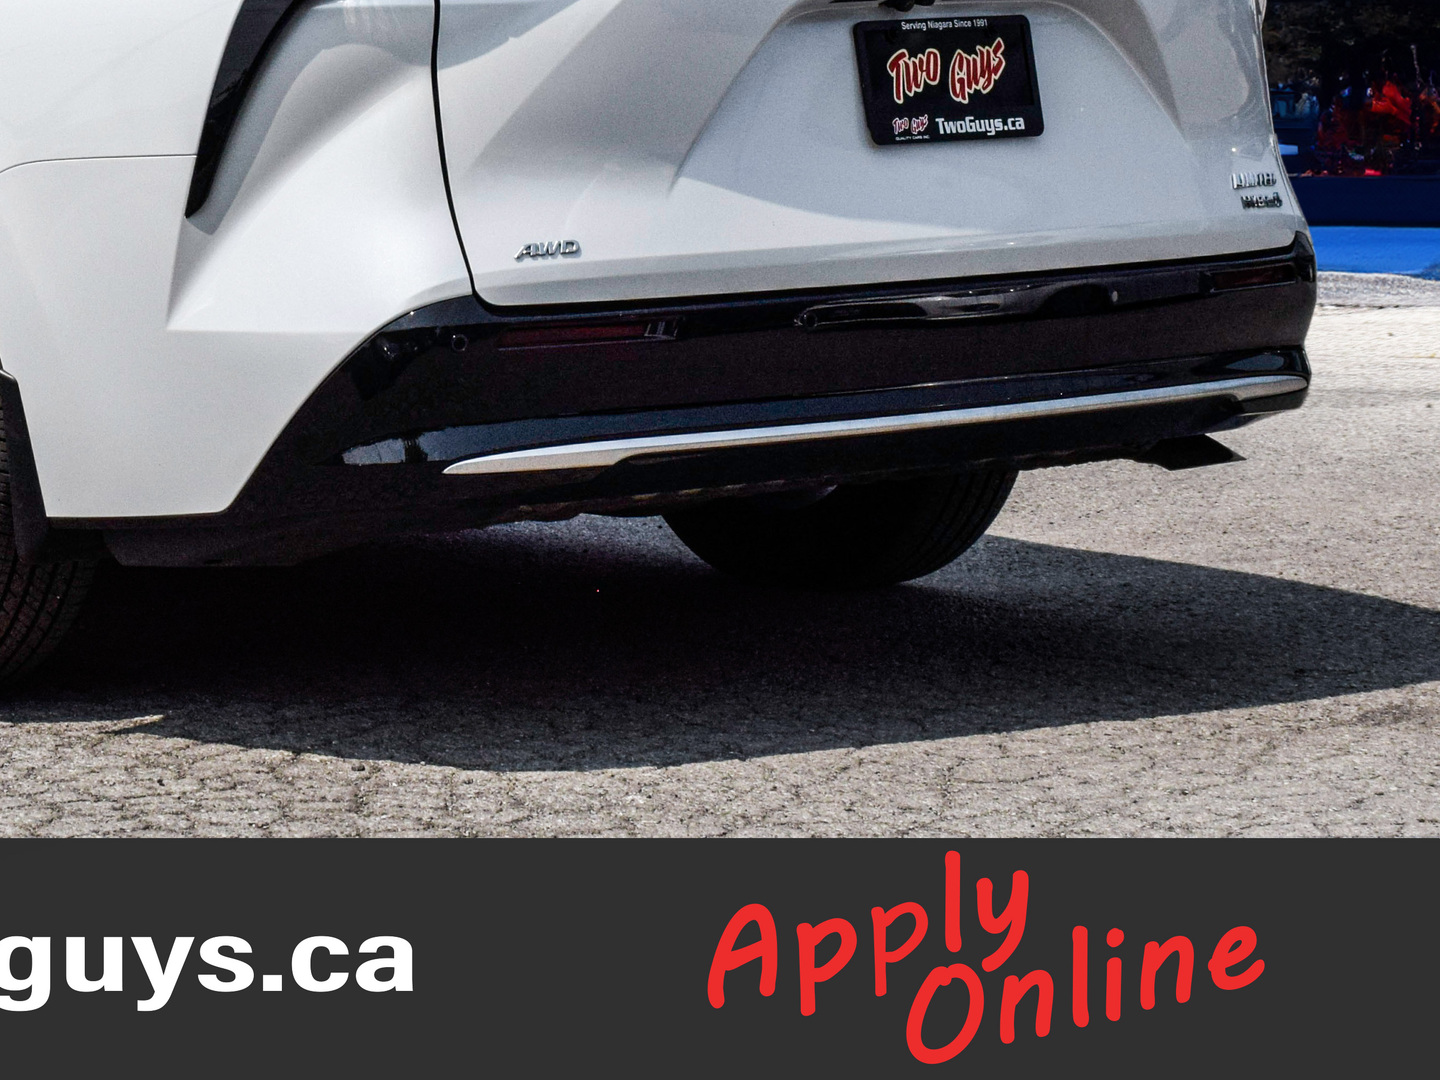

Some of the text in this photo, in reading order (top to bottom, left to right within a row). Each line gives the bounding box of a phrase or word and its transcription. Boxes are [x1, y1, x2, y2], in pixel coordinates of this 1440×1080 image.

[901, 18, 988, 31] Serving Niagara Since 1991
[935, 116, 1025, 135] TwoGuys.ca
[513, 239, 580, 260] AWD
